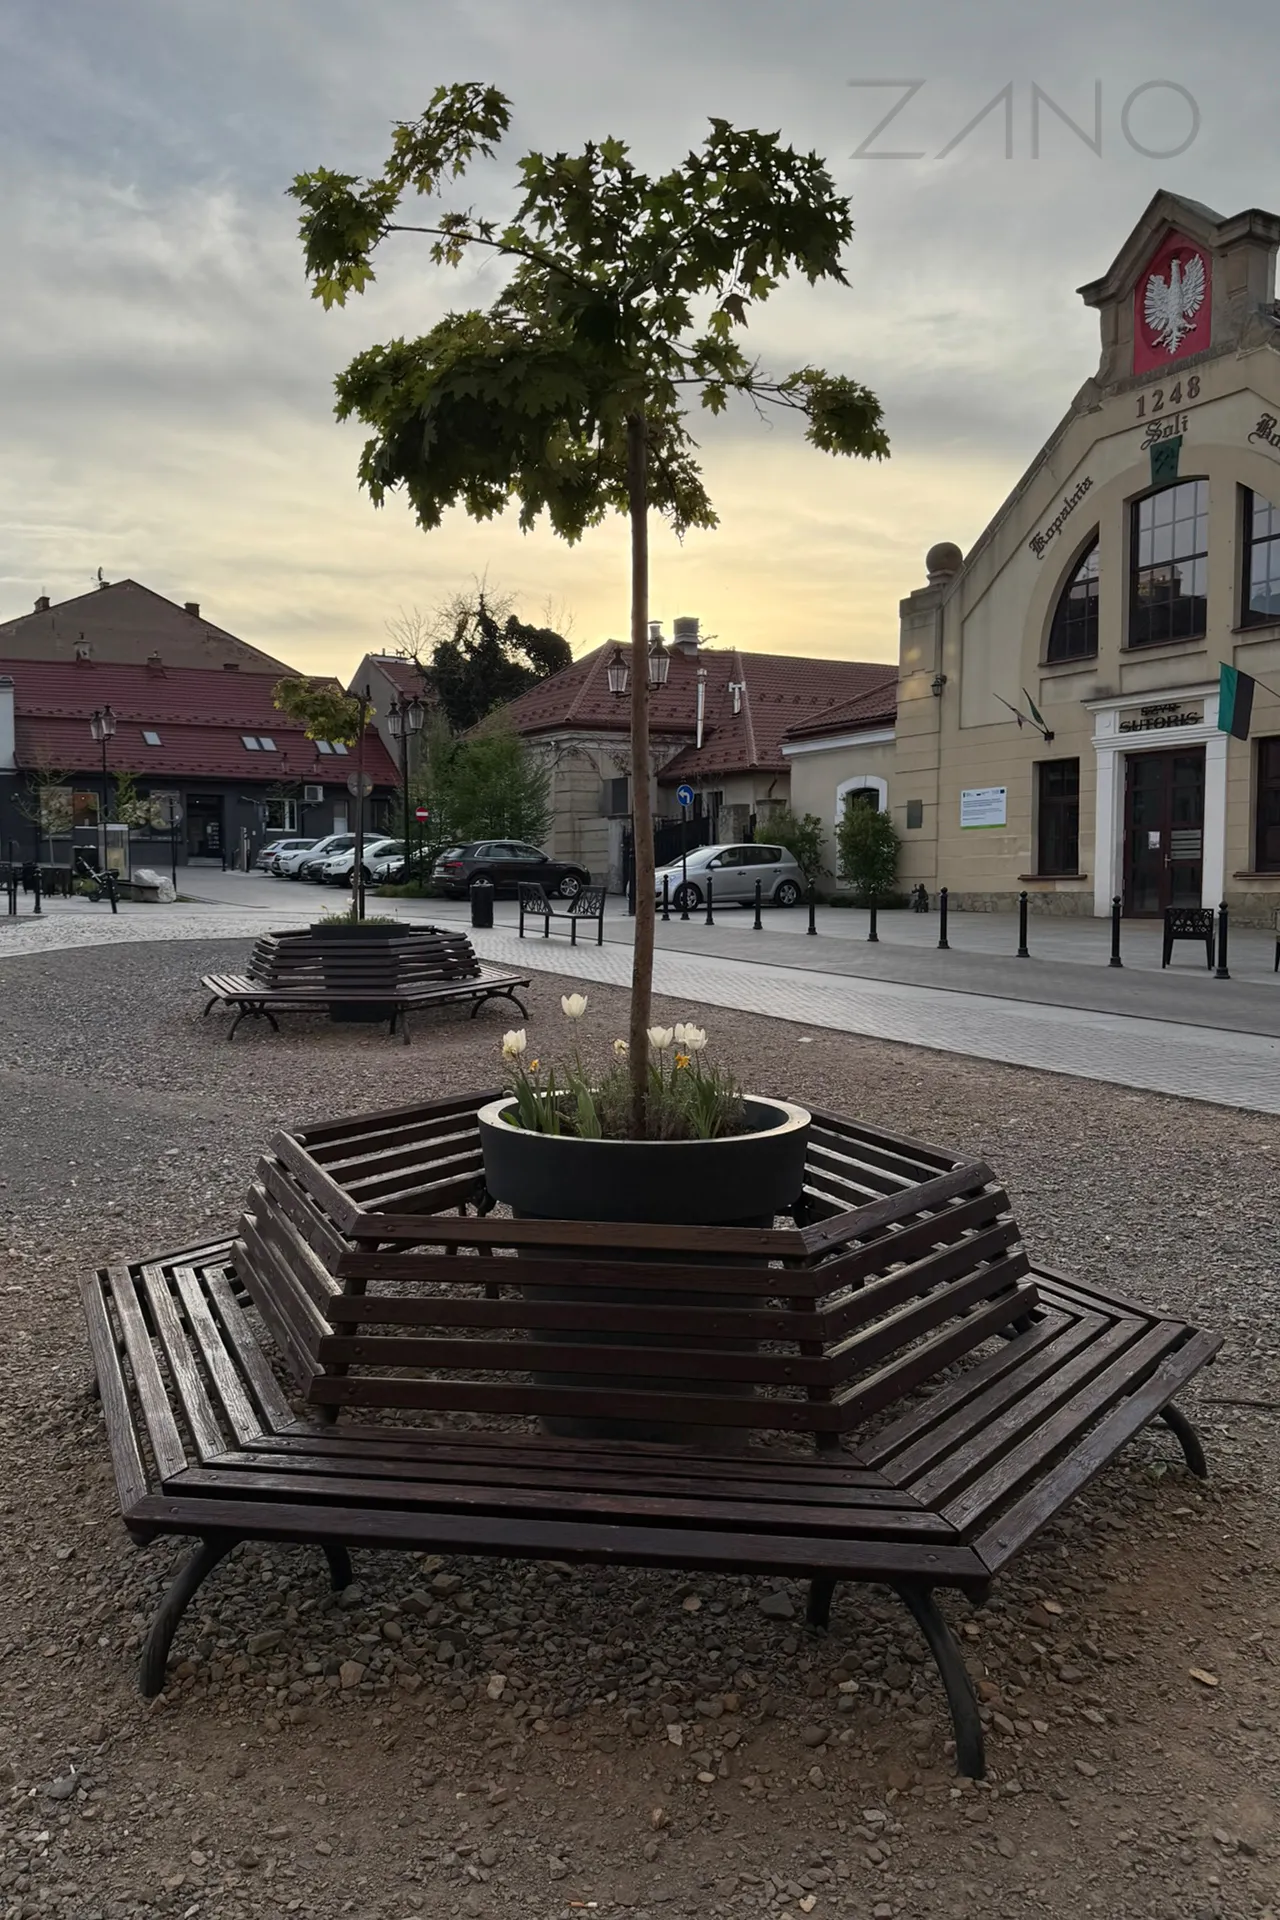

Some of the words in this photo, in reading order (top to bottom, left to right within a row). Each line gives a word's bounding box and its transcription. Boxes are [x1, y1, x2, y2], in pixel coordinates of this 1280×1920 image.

[1136, 375, 1200, 418] 1248
[1028, 476, 1094, 560] Kopalnia
[1140, 414, 1188, 450] Soli
[1119, 711, 1204, 733] SUTORIS
